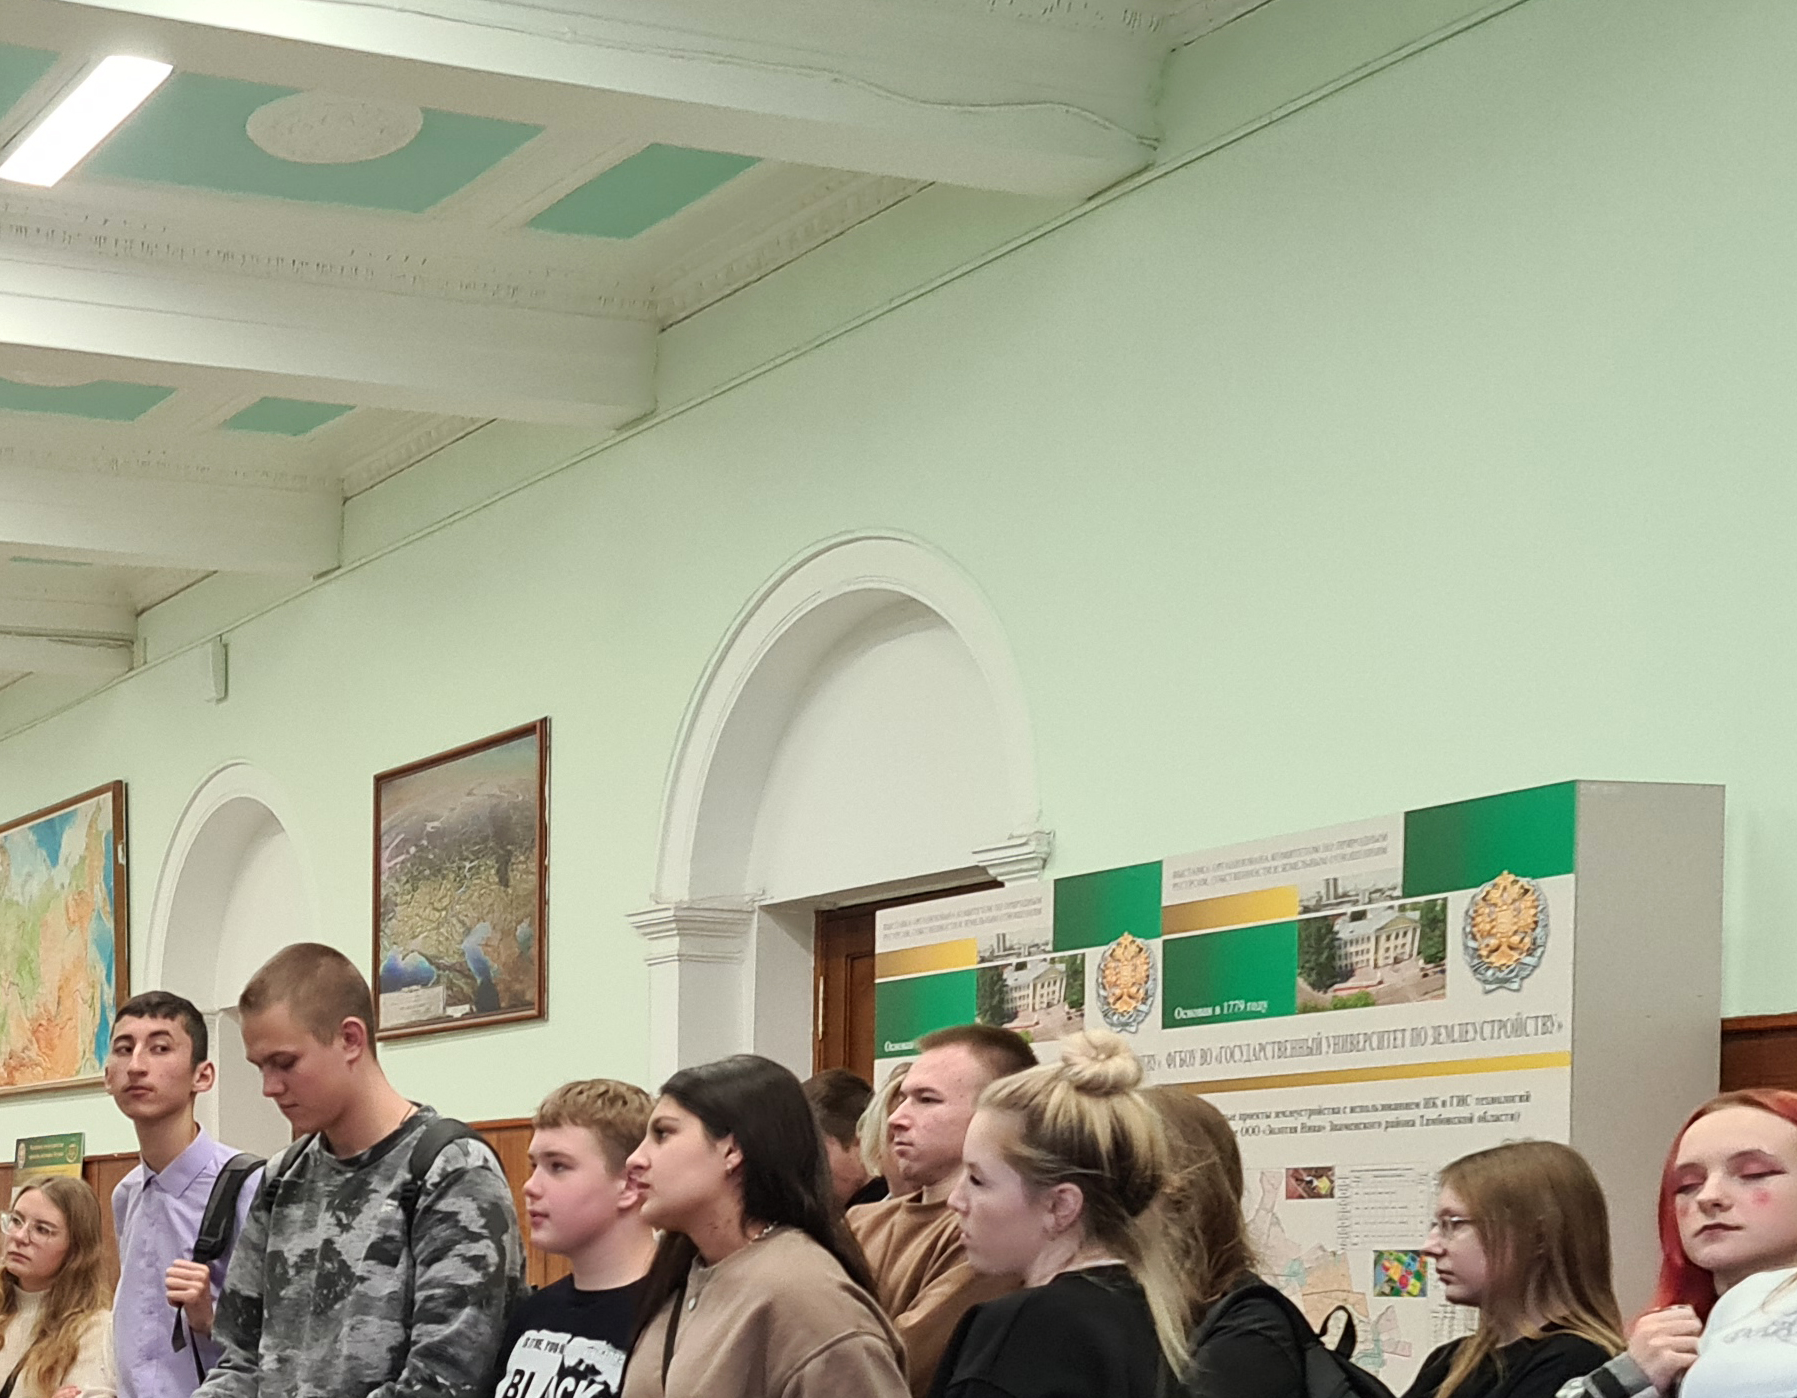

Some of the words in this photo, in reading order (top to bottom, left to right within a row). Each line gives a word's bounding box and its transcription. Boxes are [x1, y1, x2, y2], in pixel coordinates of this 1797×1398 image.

[1174, 1006, 1212, 1020] Основан
[1215, 1006, 1221, 1016] в
[1223, 1000, 1245, 1014] 1779
[1247, 1000, 1269, 1014] году
[1165, 1049, 1196, 1069] ФГБОУ
[1200, 1047, 1213, 1066] ВО
[1215, 1032, 1323, 1066] «ГОСУДАРСТВЕННЫЙ
[1325, 1028, 1406, 1055] УНИВЕРСИТЕТ
[1410, 1027, 1428, 1047] ПО
[1430, 1012, 1564, 1046] ЗЕМЛЕУСТРОЙСТВУ»
